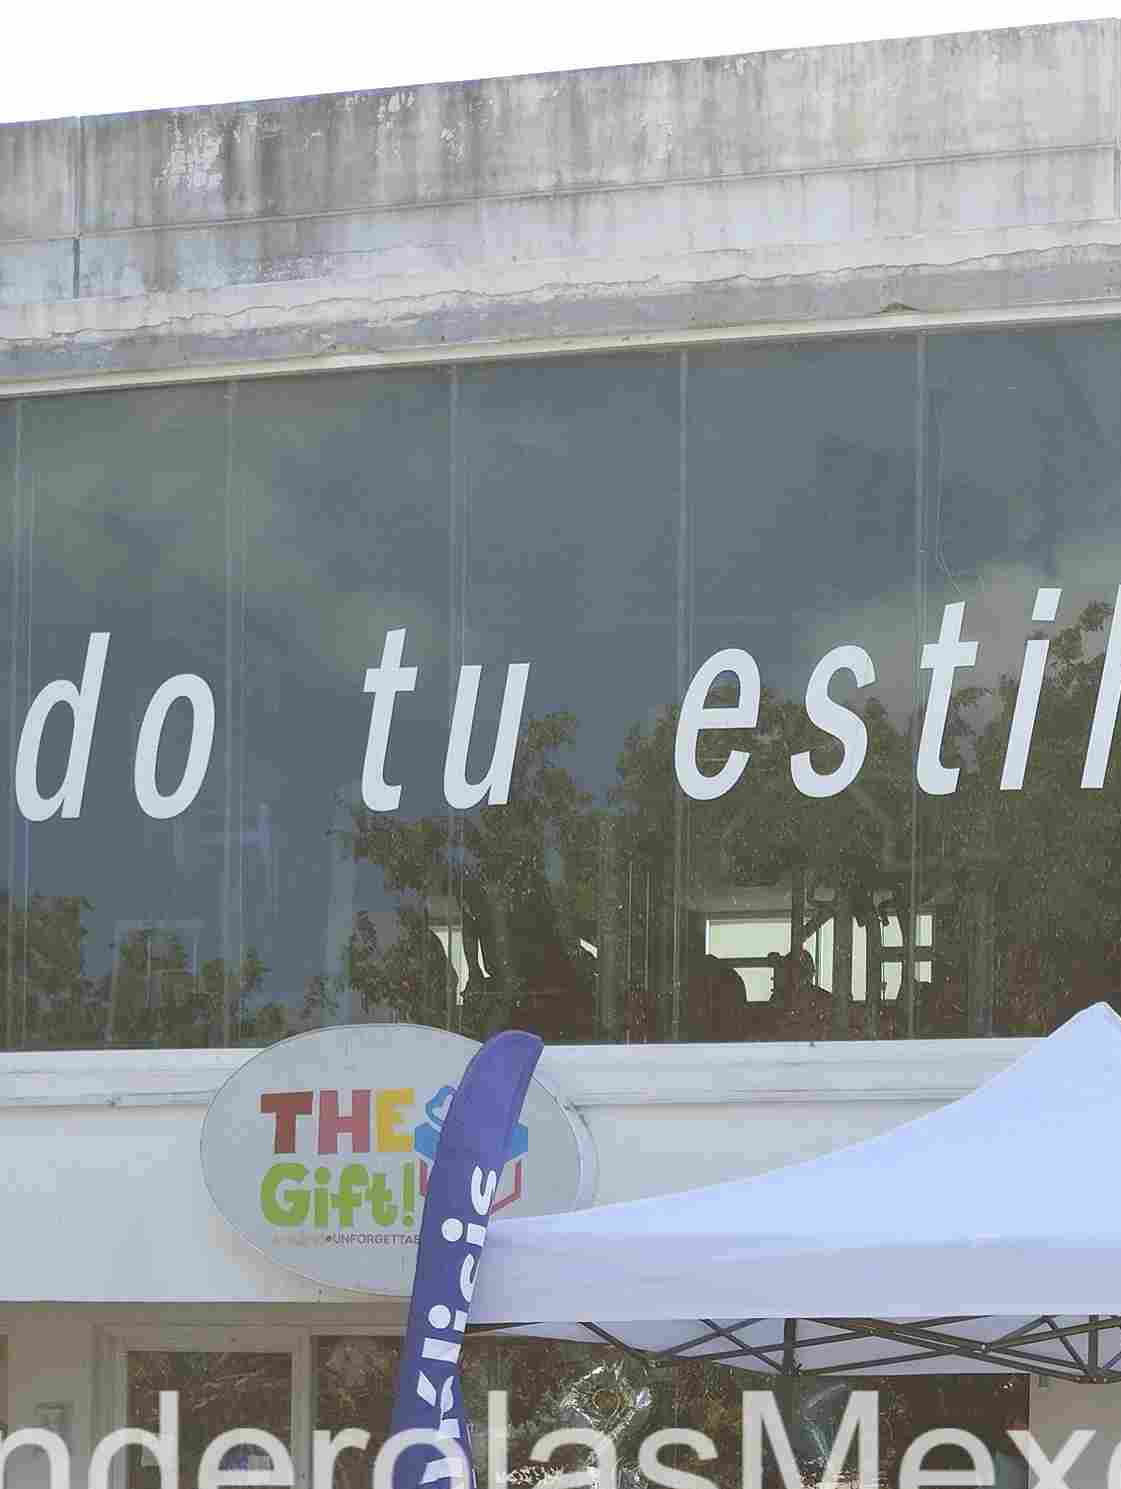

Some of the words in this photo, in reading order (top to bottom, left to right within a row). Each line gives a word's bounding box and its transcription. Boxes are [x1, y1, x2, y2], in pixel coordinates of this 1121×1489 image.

[15, 631, 215, 822] do
[361, 628, 530, 812] tu
[260, 1087, 415, 1155] THE
[260, 1162, 415, 1228] Gift!
